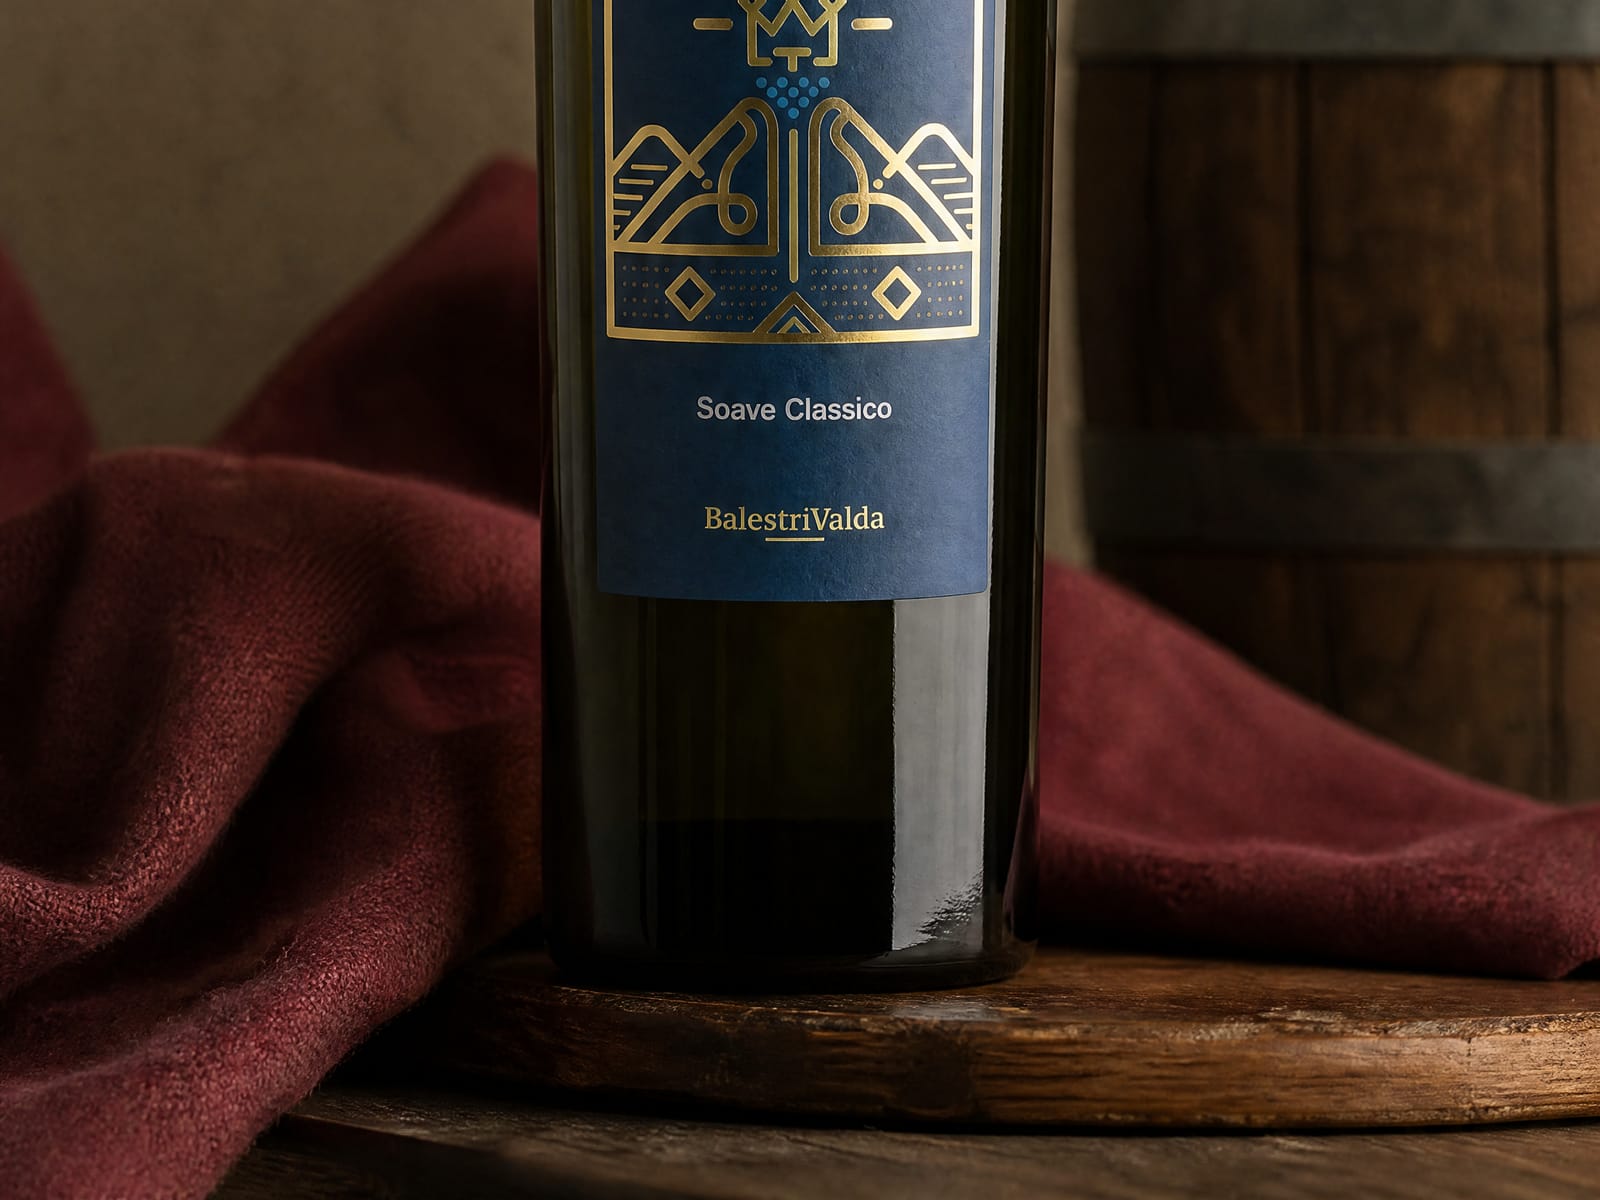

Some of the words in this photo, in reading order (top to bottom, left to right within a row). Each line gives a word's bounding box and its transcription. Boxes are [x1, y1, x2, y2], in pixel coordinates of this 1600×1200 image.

[696, 395, 776, 421] Soave
[785, 396, 893, 421] Classico
[704, 505, 885, 531] BalestriValda
